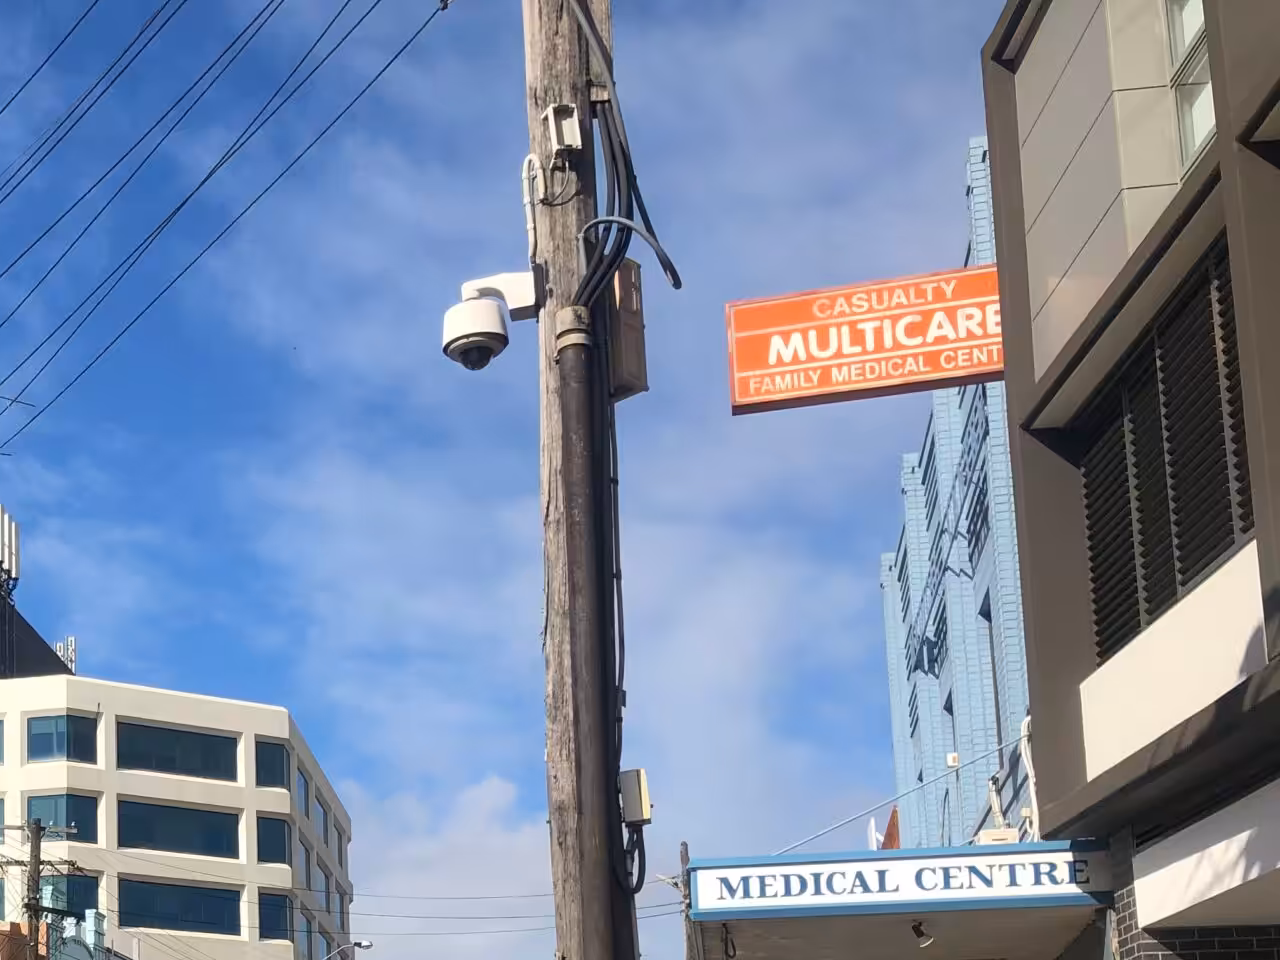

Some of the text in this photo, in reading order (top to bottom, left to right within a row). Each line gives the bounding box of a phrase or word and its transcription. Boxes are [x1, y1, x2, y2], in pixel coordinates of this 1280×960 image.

[812, 280, 957, 318] CASUALTY
[768, 304, 1002, 365] MULTICARE
[749, 344, 1002, 395] FAMILY MEDICAL CENT
[716, 859, 1091, 900] MEDICAL CENTRE
